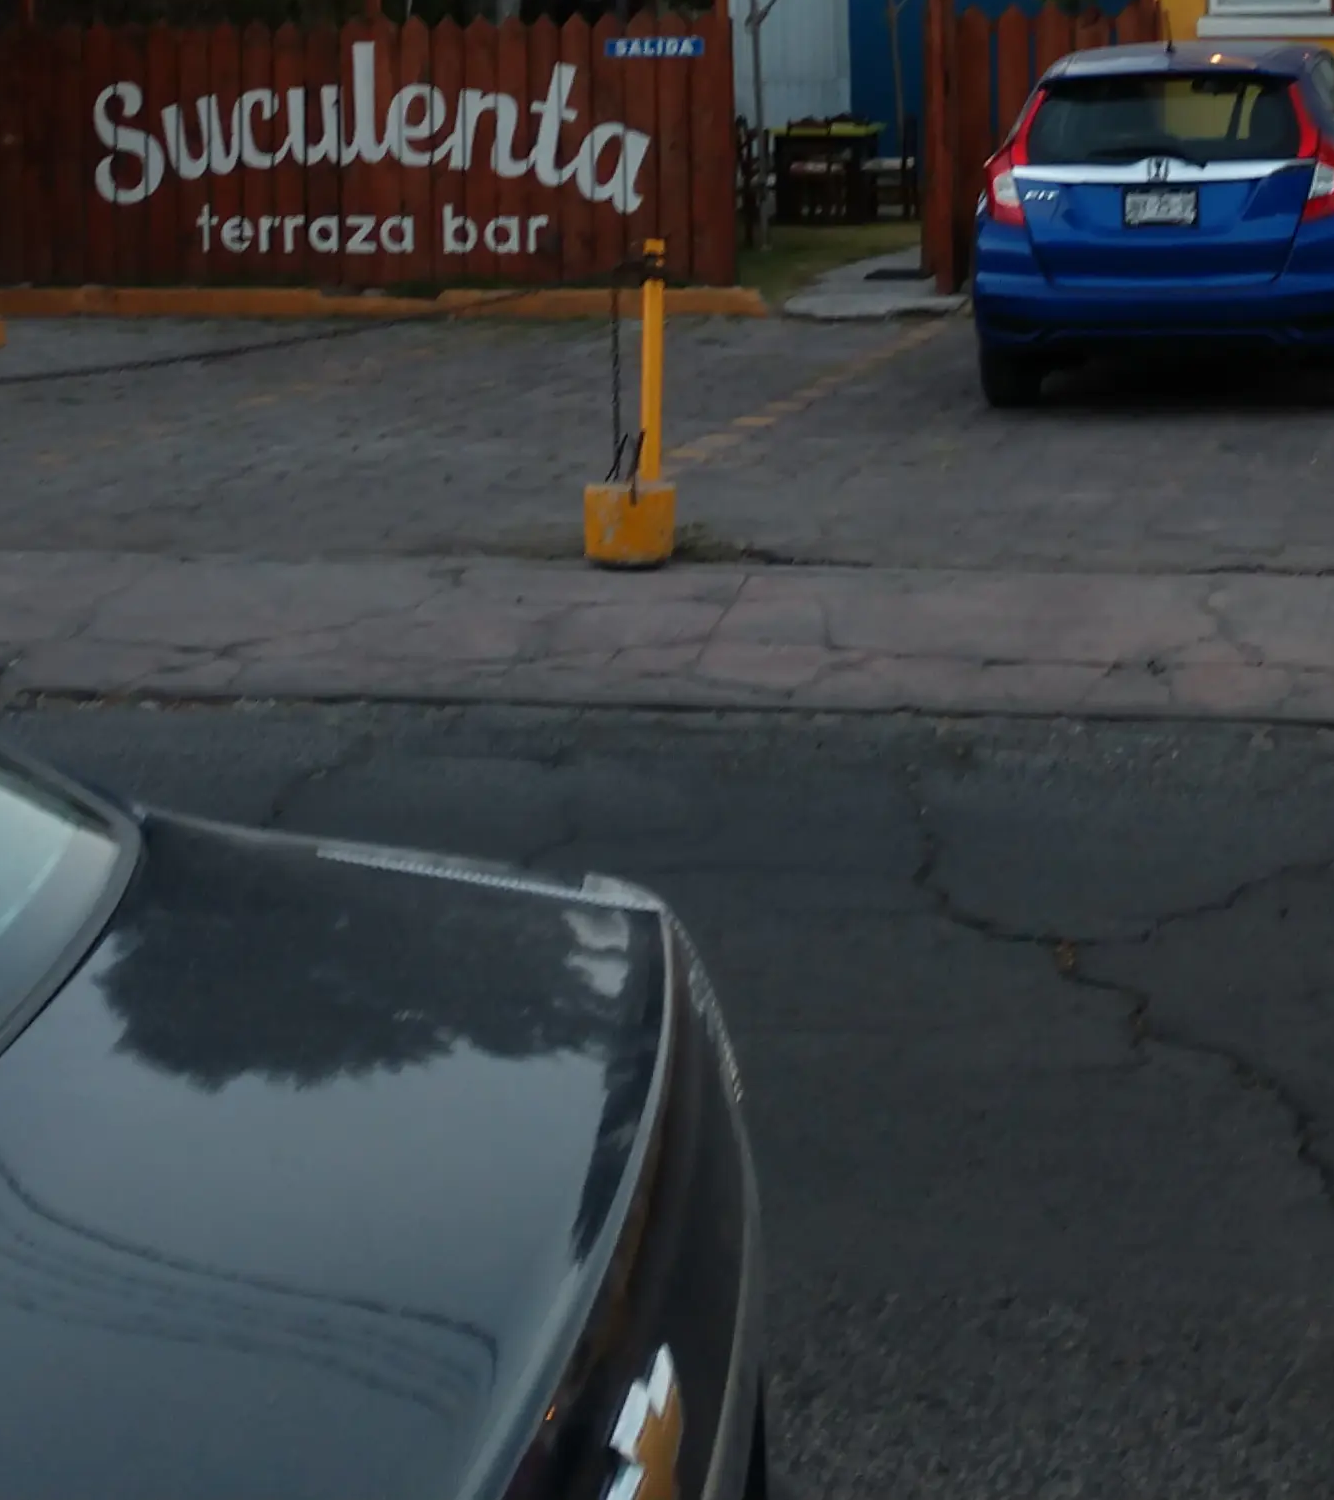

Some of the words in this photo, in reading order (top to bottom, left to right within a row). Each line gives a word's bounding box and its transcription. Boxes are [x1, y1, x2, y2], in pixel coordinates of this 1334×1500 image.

[615, 37, 695, 57] SALIDA
[93, 41, 651, 214] Suculenta
[196, 203, 415, 255] terraza
[442, 203, 549, 255] bar
